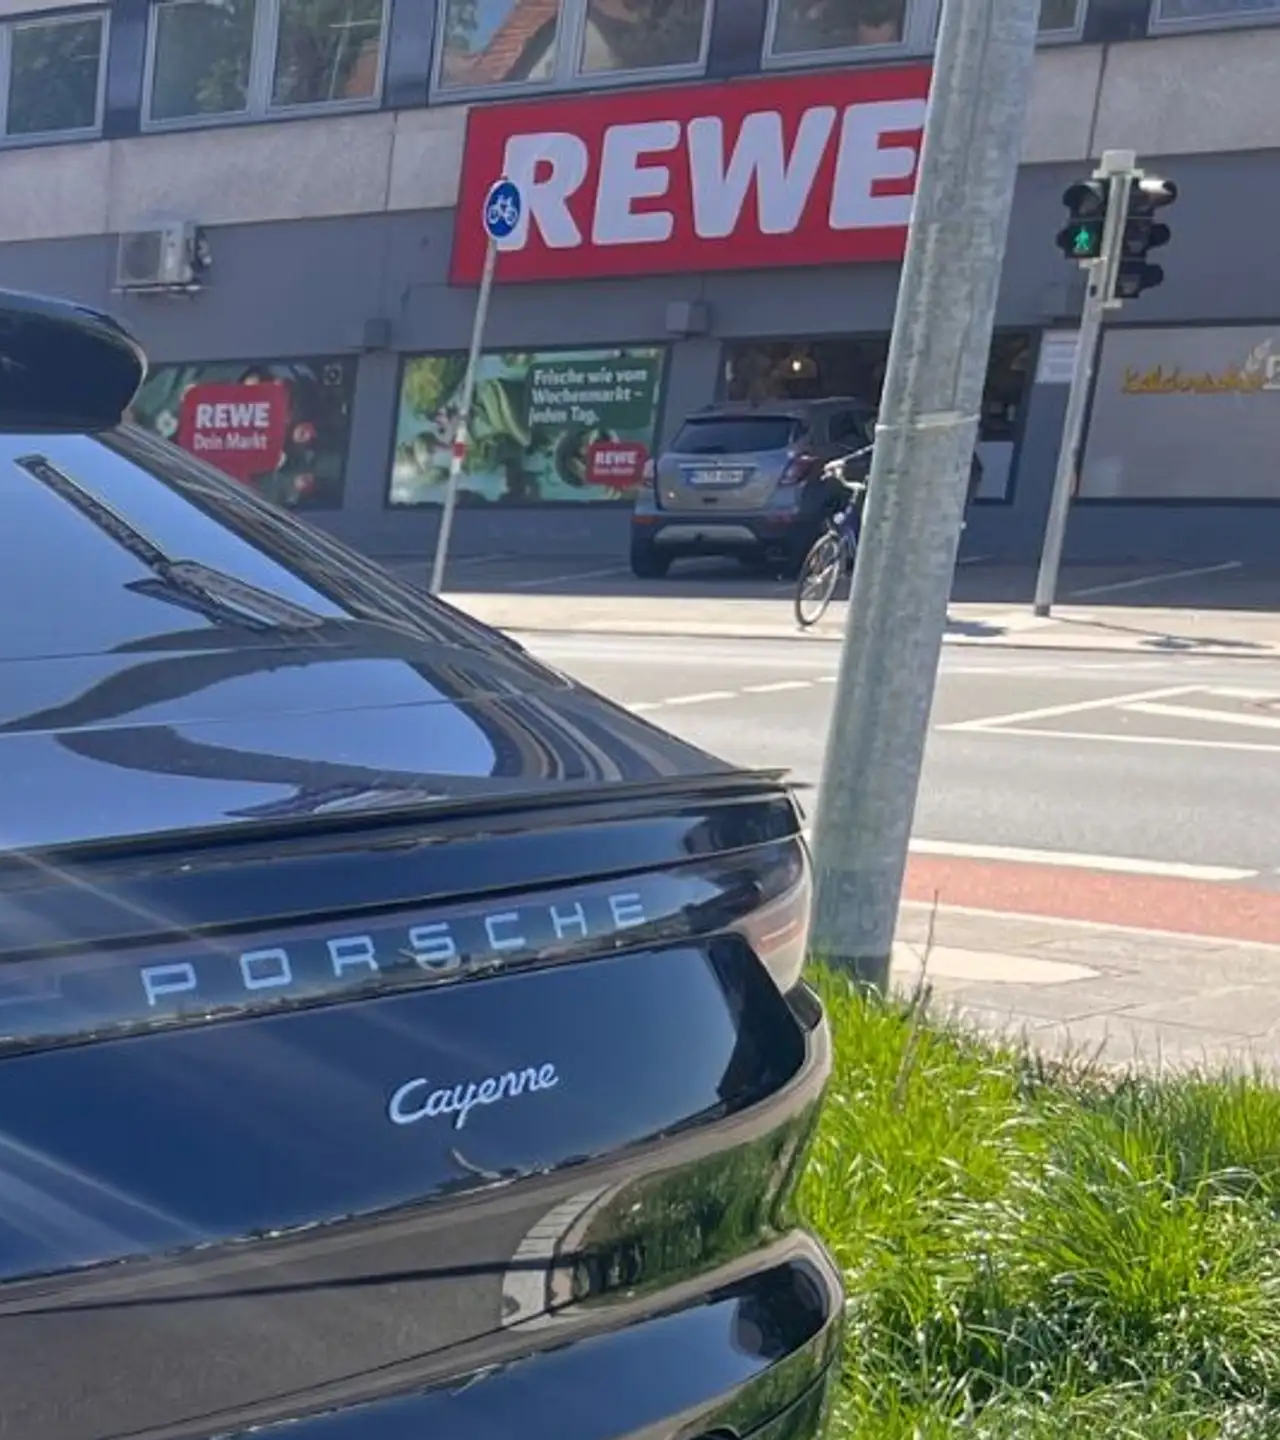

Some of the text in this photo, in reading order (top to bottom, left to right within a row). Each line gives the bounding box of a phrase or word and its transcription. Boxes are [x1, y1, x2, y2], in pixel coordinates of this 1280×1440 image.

[496, 98, 929, 252] REWE
[533, 366, 648, 386] Frische wie vom
[531, 386, 631, 404] Wochenmarkt
[195, 402, 271, 429] REWE
[192, 431, 267, 451] Dein Markt
[594, 451, 638, 465] REWE
[140, 892, 647, 1005] PORSCHE
[387, 1061, 559, 1130] Cayenne
